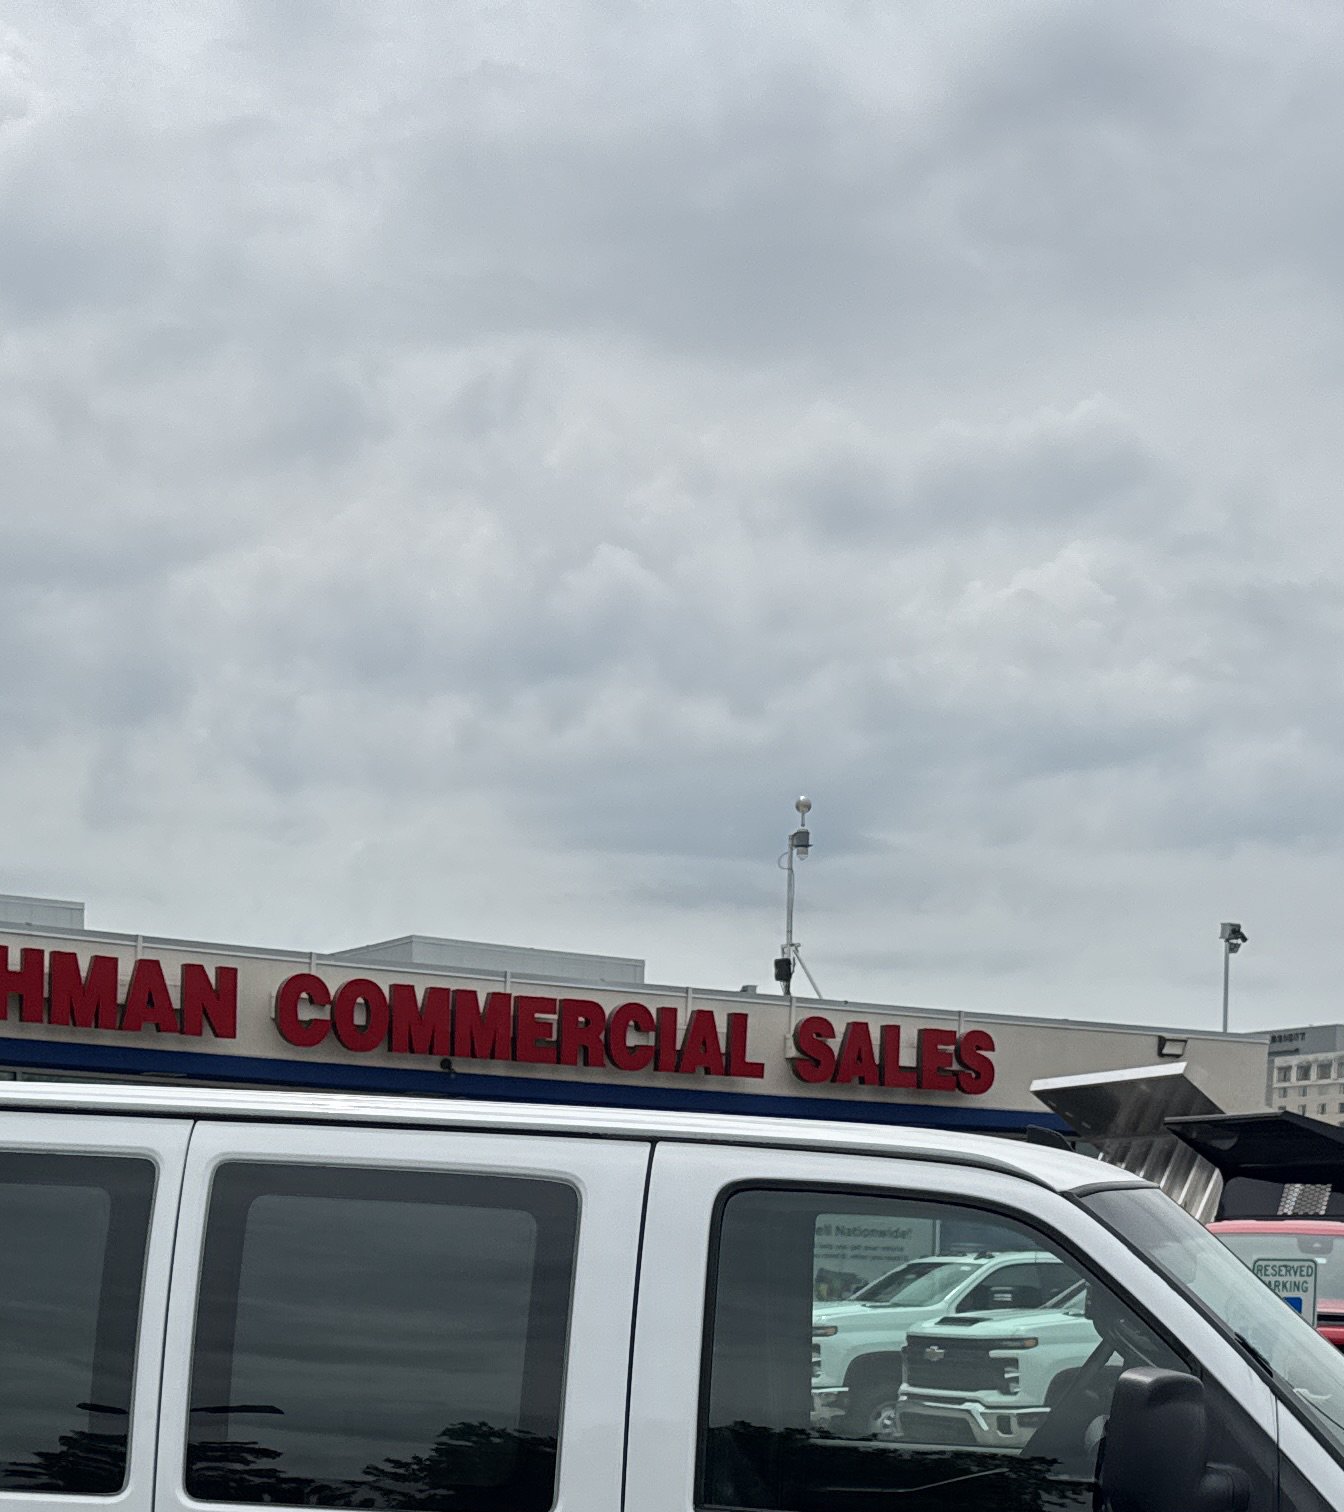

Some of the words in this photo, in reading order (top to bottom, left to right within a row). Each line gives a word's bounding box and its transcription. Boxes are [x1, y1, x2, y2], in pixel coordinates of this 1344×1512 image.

[274, 971, 765, 1079] COMMERCIAL
[791, 1015, 996, 1096] SALES
[1256, 1264, 1314, 1277] RESERVED
[1267, 1280, 1309, 1293] ARKING
